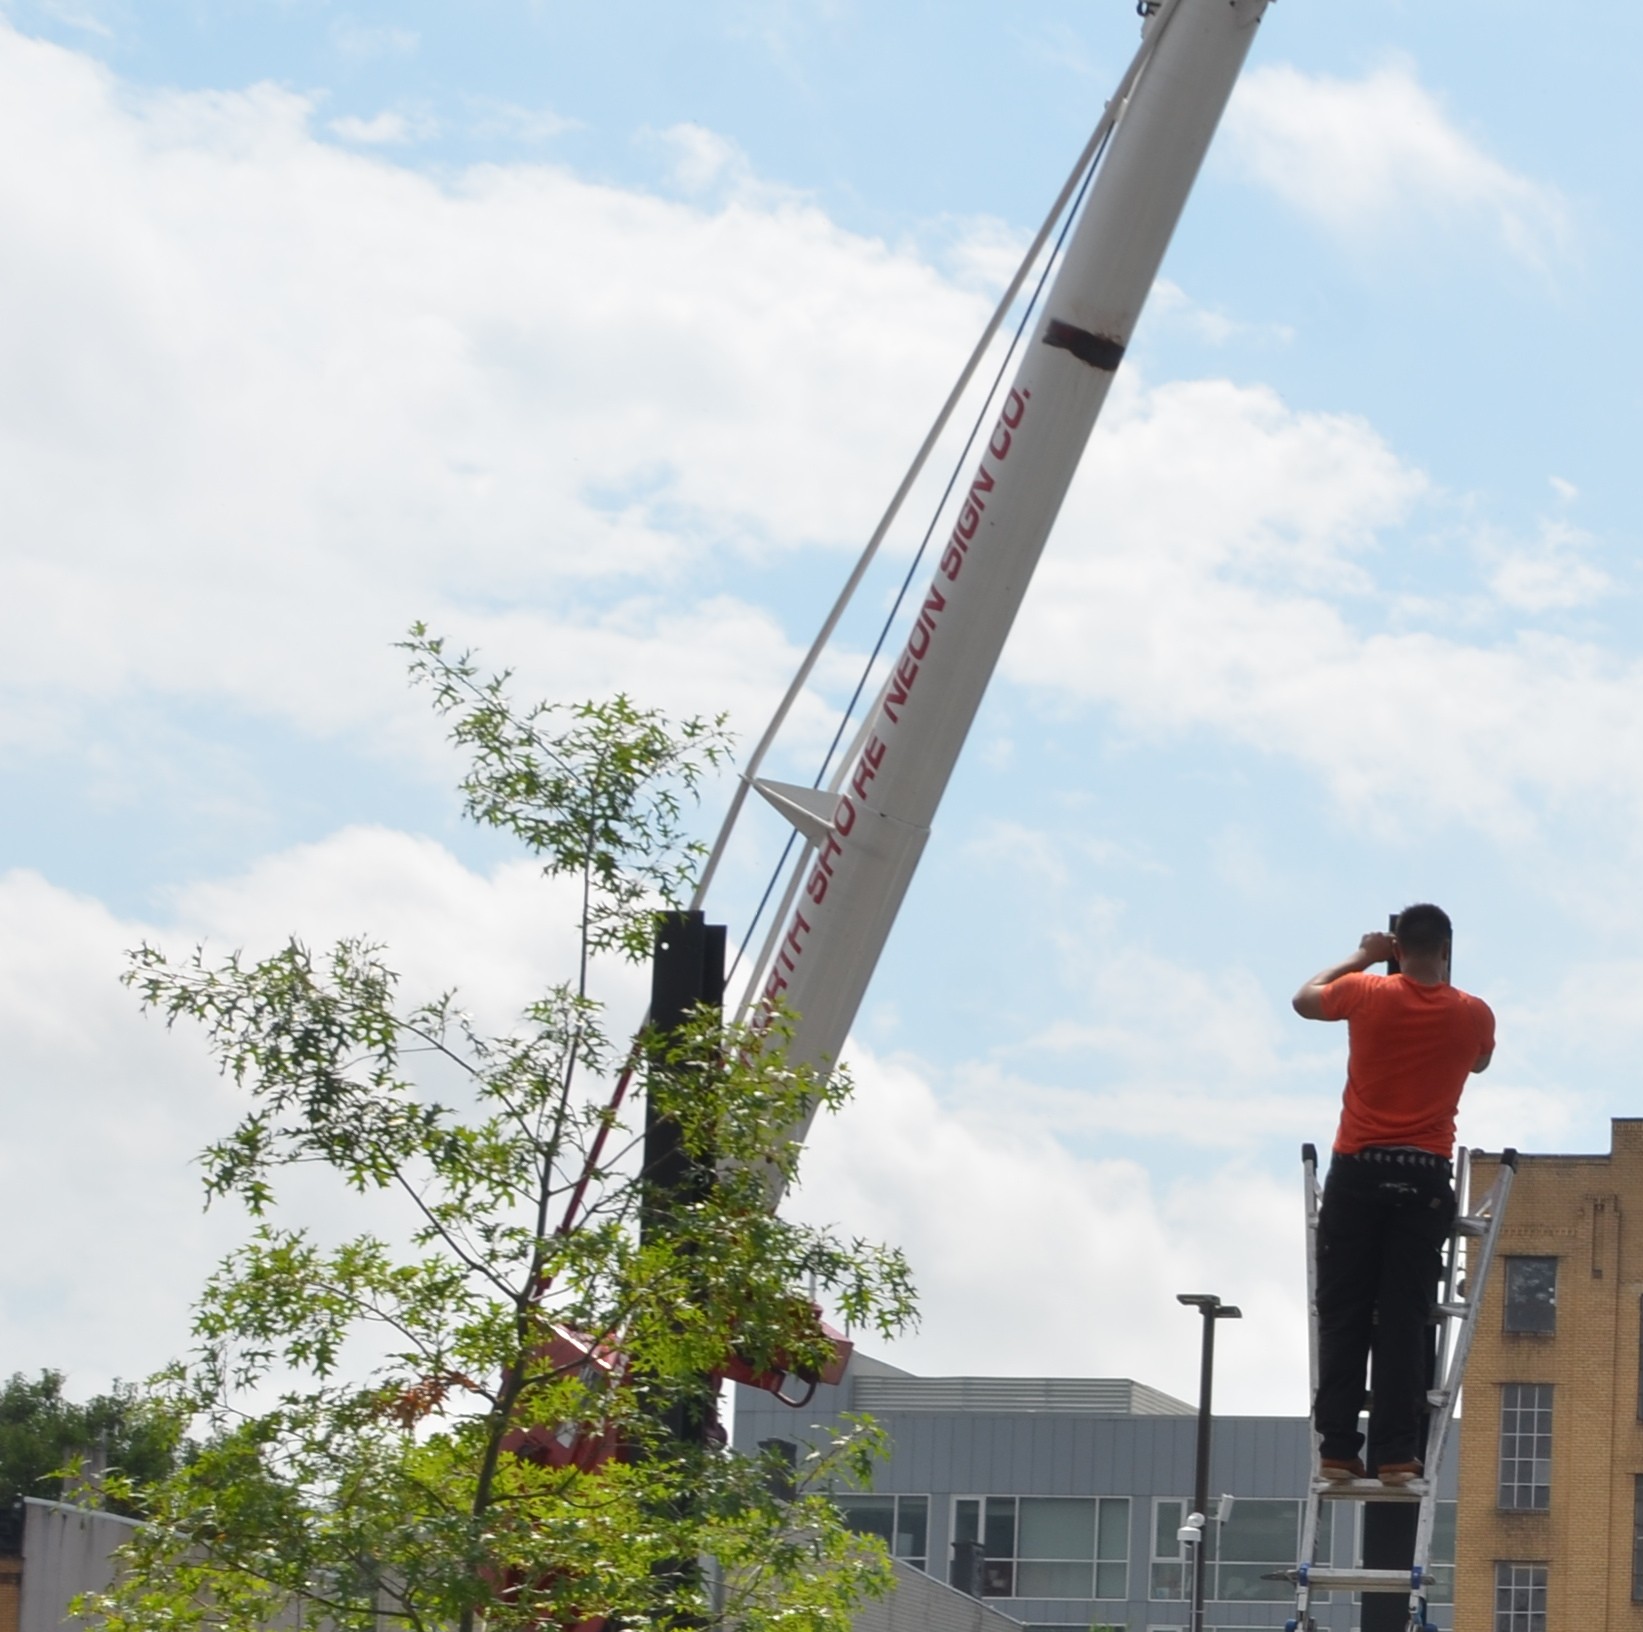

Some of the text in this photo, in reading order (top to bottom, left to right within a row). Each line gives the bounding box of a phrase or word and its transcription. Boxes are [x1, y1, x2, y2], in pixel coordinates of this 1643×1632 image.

[741, 387, 1032, 1066] ORTH SHORE NEON SIGN CO.
